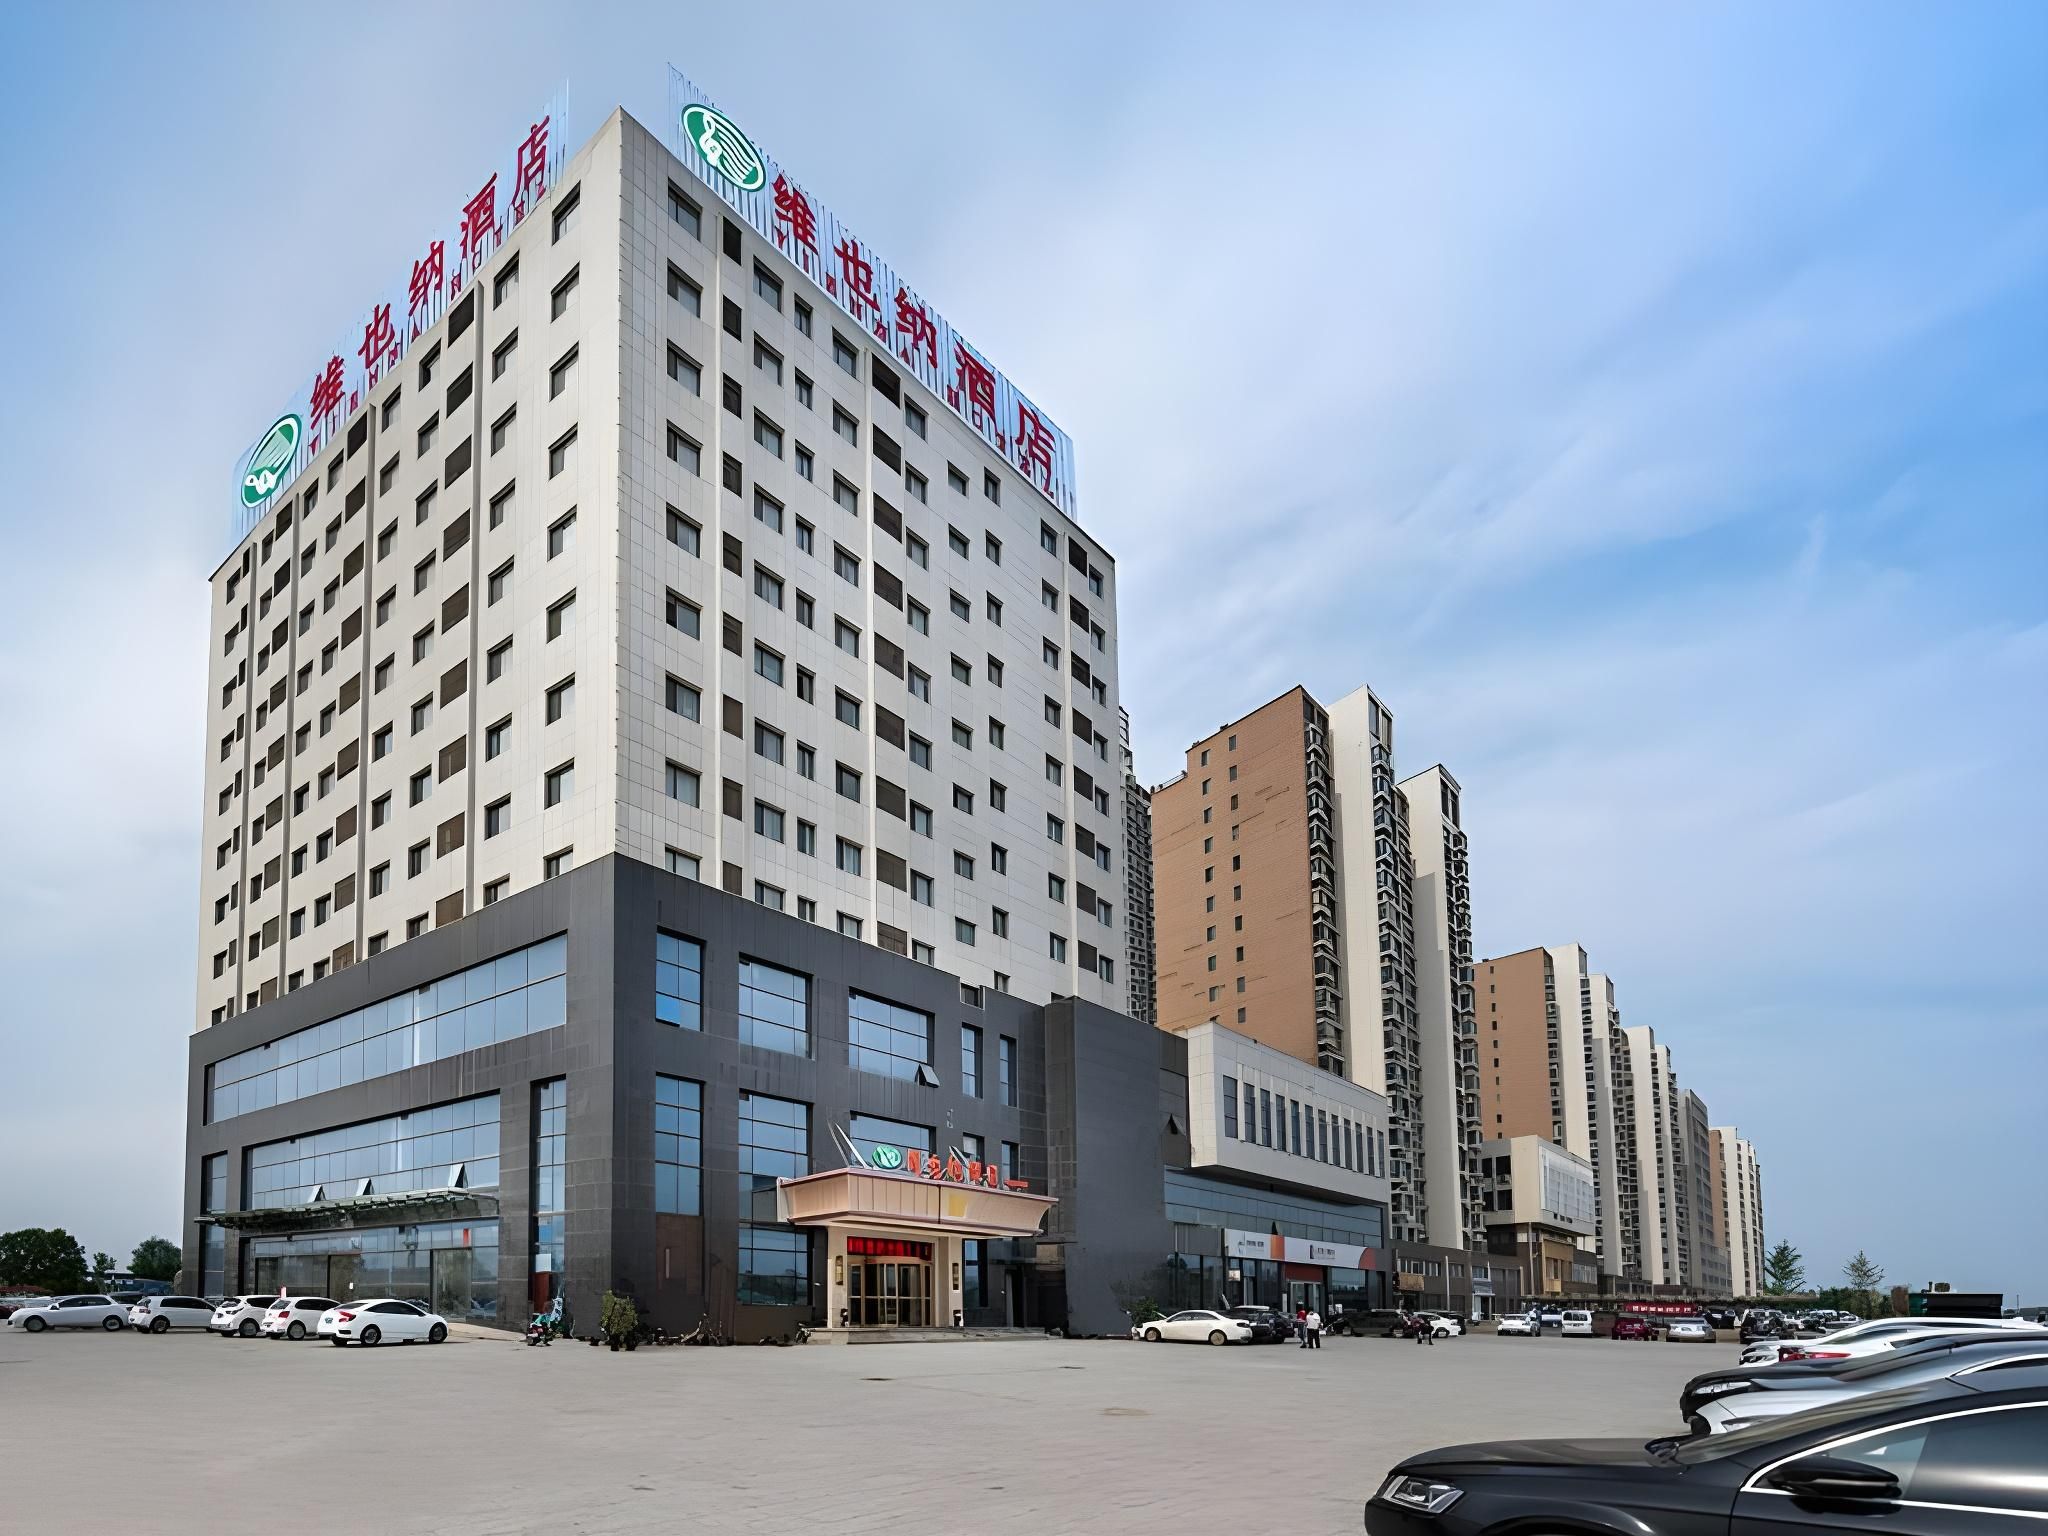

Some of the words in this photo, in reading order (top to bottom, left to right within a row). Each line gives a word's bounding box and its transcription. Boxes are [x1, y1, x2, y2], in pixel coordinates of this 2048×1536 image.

[310, 115, 550, 430] 维也纳酒店
[772, 174, 1056, 492] 维也纳酒店
